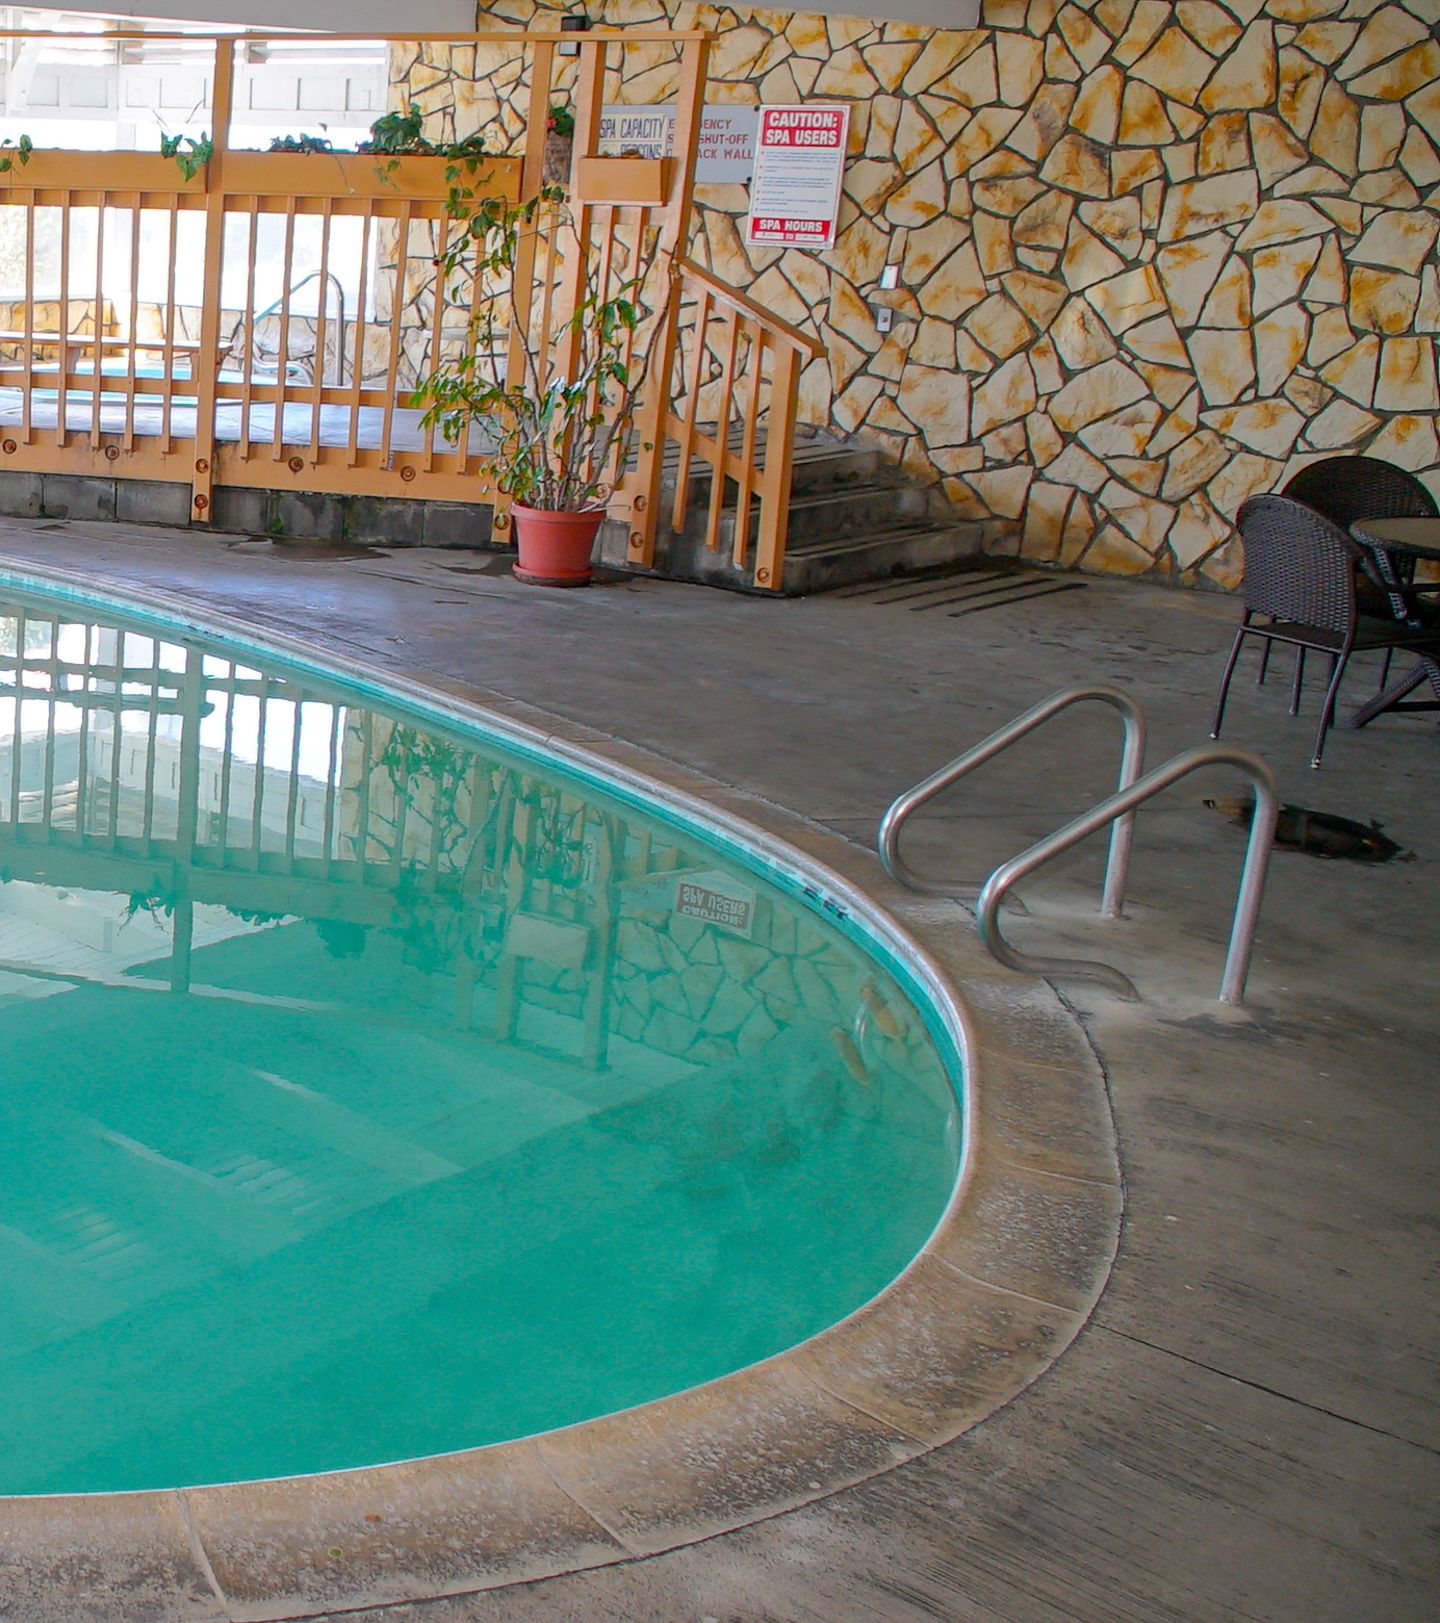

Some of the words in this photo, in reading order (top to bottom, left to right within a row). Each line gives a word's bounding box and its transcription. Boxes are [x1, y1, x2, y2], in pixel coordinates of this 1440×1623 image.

[600, 118, 616, 138] SPA
[620, 115, 666, 138] CAPACITY
[769, 111, 838, 128] CAUTION:
[698, 133, 749, 144] SHUT-OFF
[766, 128, 791, 144] SPA
[795, 129, 838, 145] USERS
[724, 149, 754, 159] WALL
[759, 219, 780, 230] SPA
[784, 220, 823, 232] HOURS
